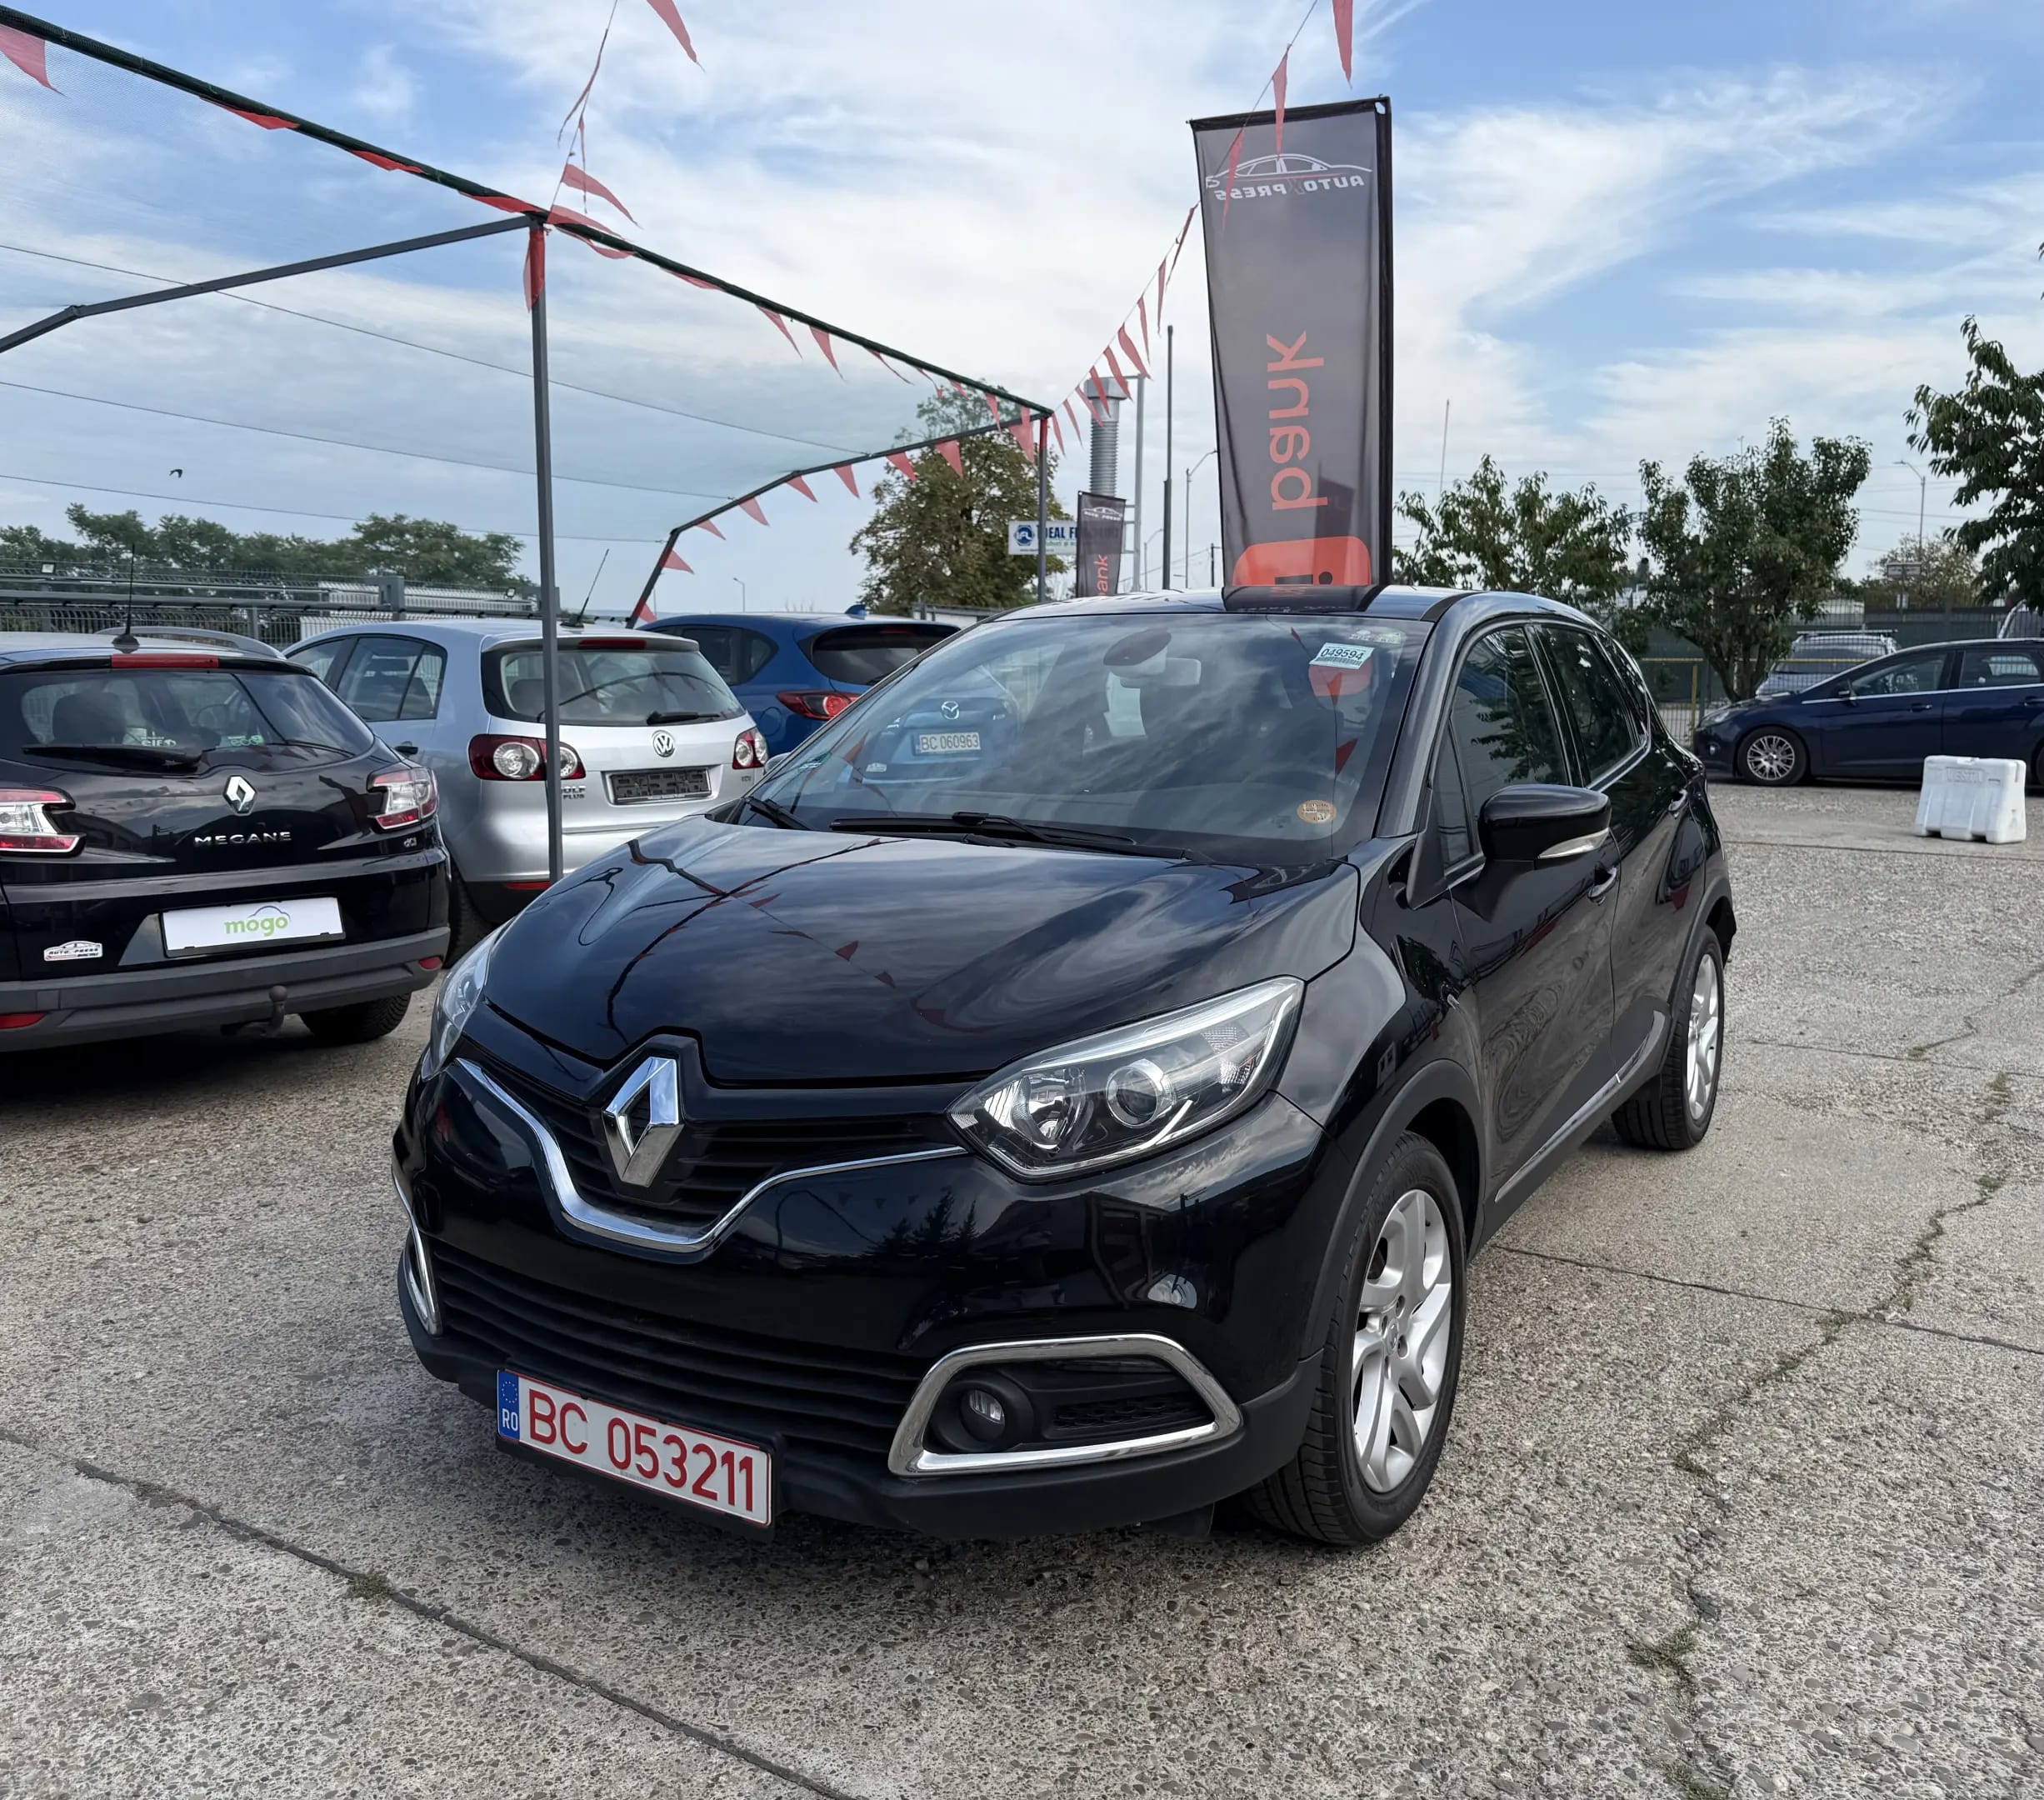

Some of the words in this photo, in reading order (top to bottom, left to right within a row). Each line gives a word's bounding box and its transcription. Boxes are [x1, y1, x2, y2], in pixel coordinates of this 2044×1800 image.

[1093, 554, 1109, 596] ank
[1321, 648, 1364, 660] 049594
[921, 737, 938, 750] BC
[940, 734, 979, 749] 060963
[194, 832, 292, 847] MEGANE
[223, 917, 289, 937] mogo
[502, 1408, 518, 1432] RO
[528, 1388, 588, 1455] BC
[607, 1417, 753, 1512] 053211
